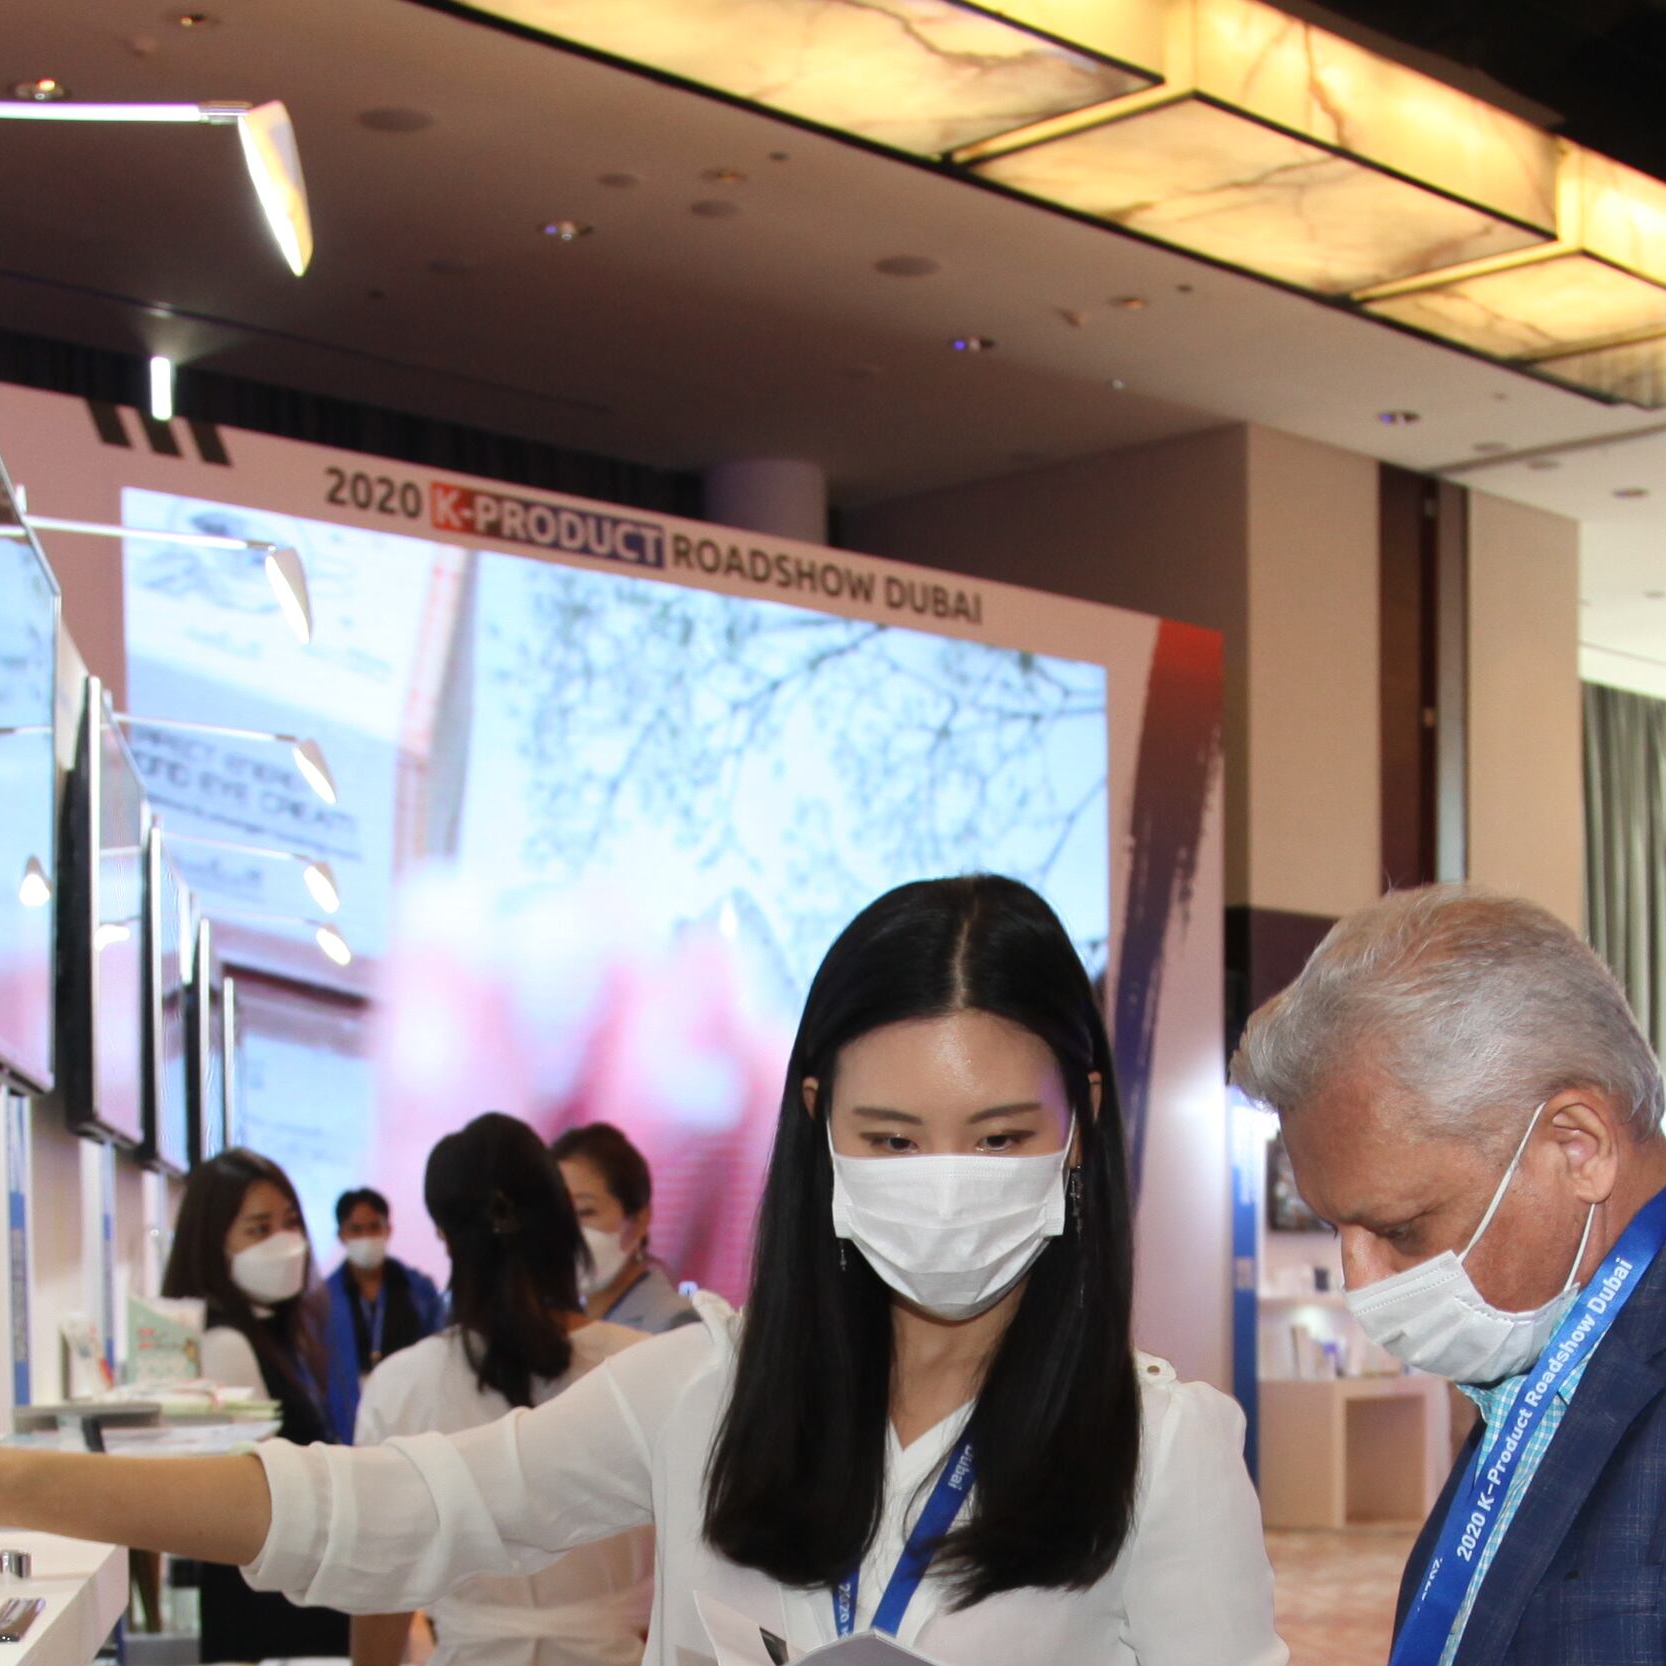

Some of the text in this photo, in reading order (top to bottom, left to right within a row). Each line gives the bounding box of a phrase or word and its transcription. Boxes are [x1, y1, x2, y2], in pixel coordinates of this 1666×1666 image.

[325, 467, 984, 625] 2020 K-PRODUCT ROADSHOW DUBAI
[1456, 1256, 1635, 1563] 2020 K-Product Roadshow Dubai
